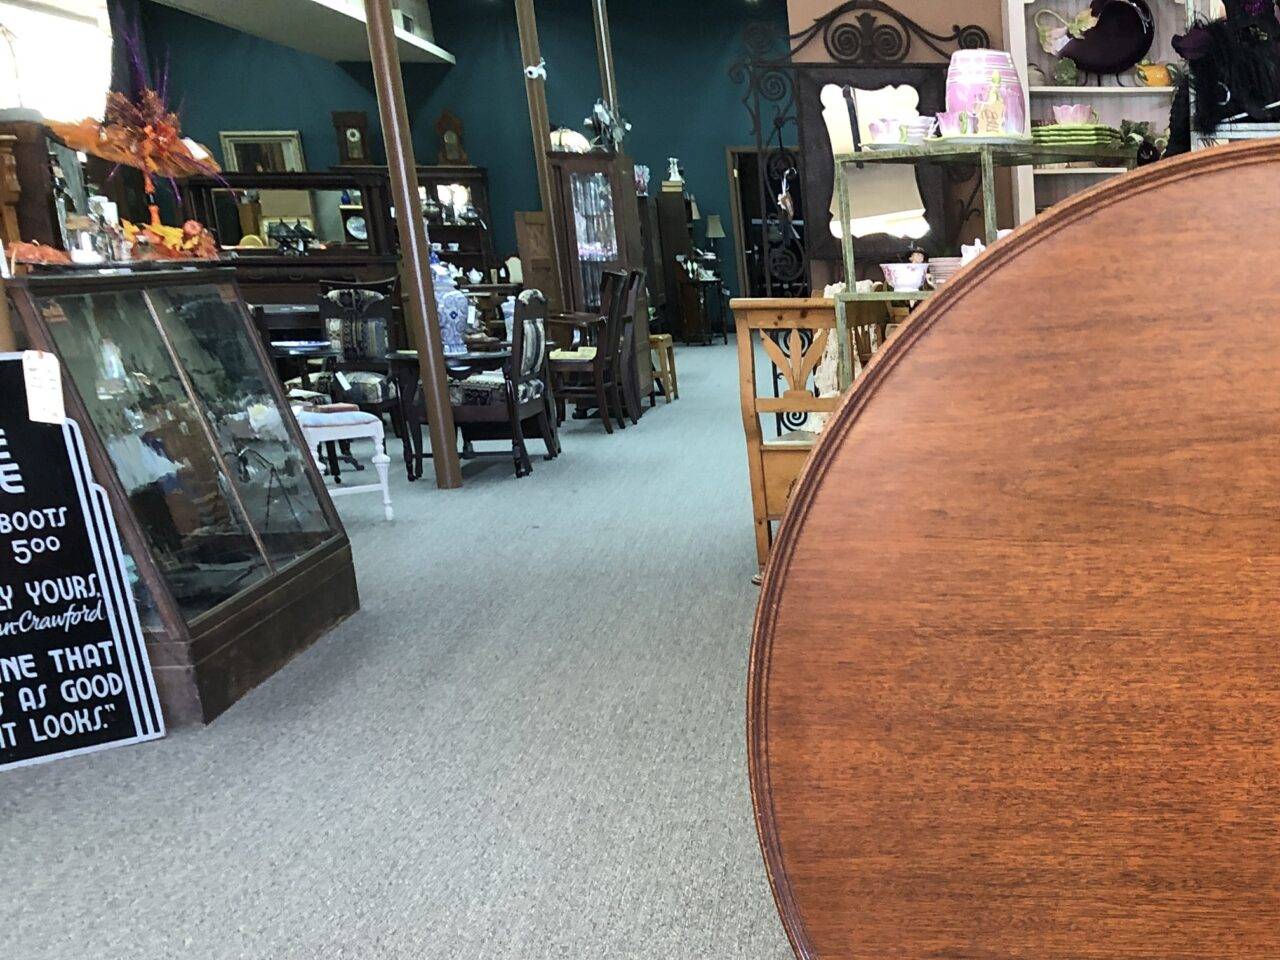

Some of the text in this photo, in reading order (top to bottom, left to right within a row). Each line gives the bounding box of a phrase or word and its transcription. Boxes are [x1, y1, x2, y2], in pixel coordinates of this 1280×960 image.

[18, 599, 105, 633] Crawford
[48, 640, 113, 673] THAT
[18, 683, 47, 712] AS
[60, 672, 123, 703] GOOD
